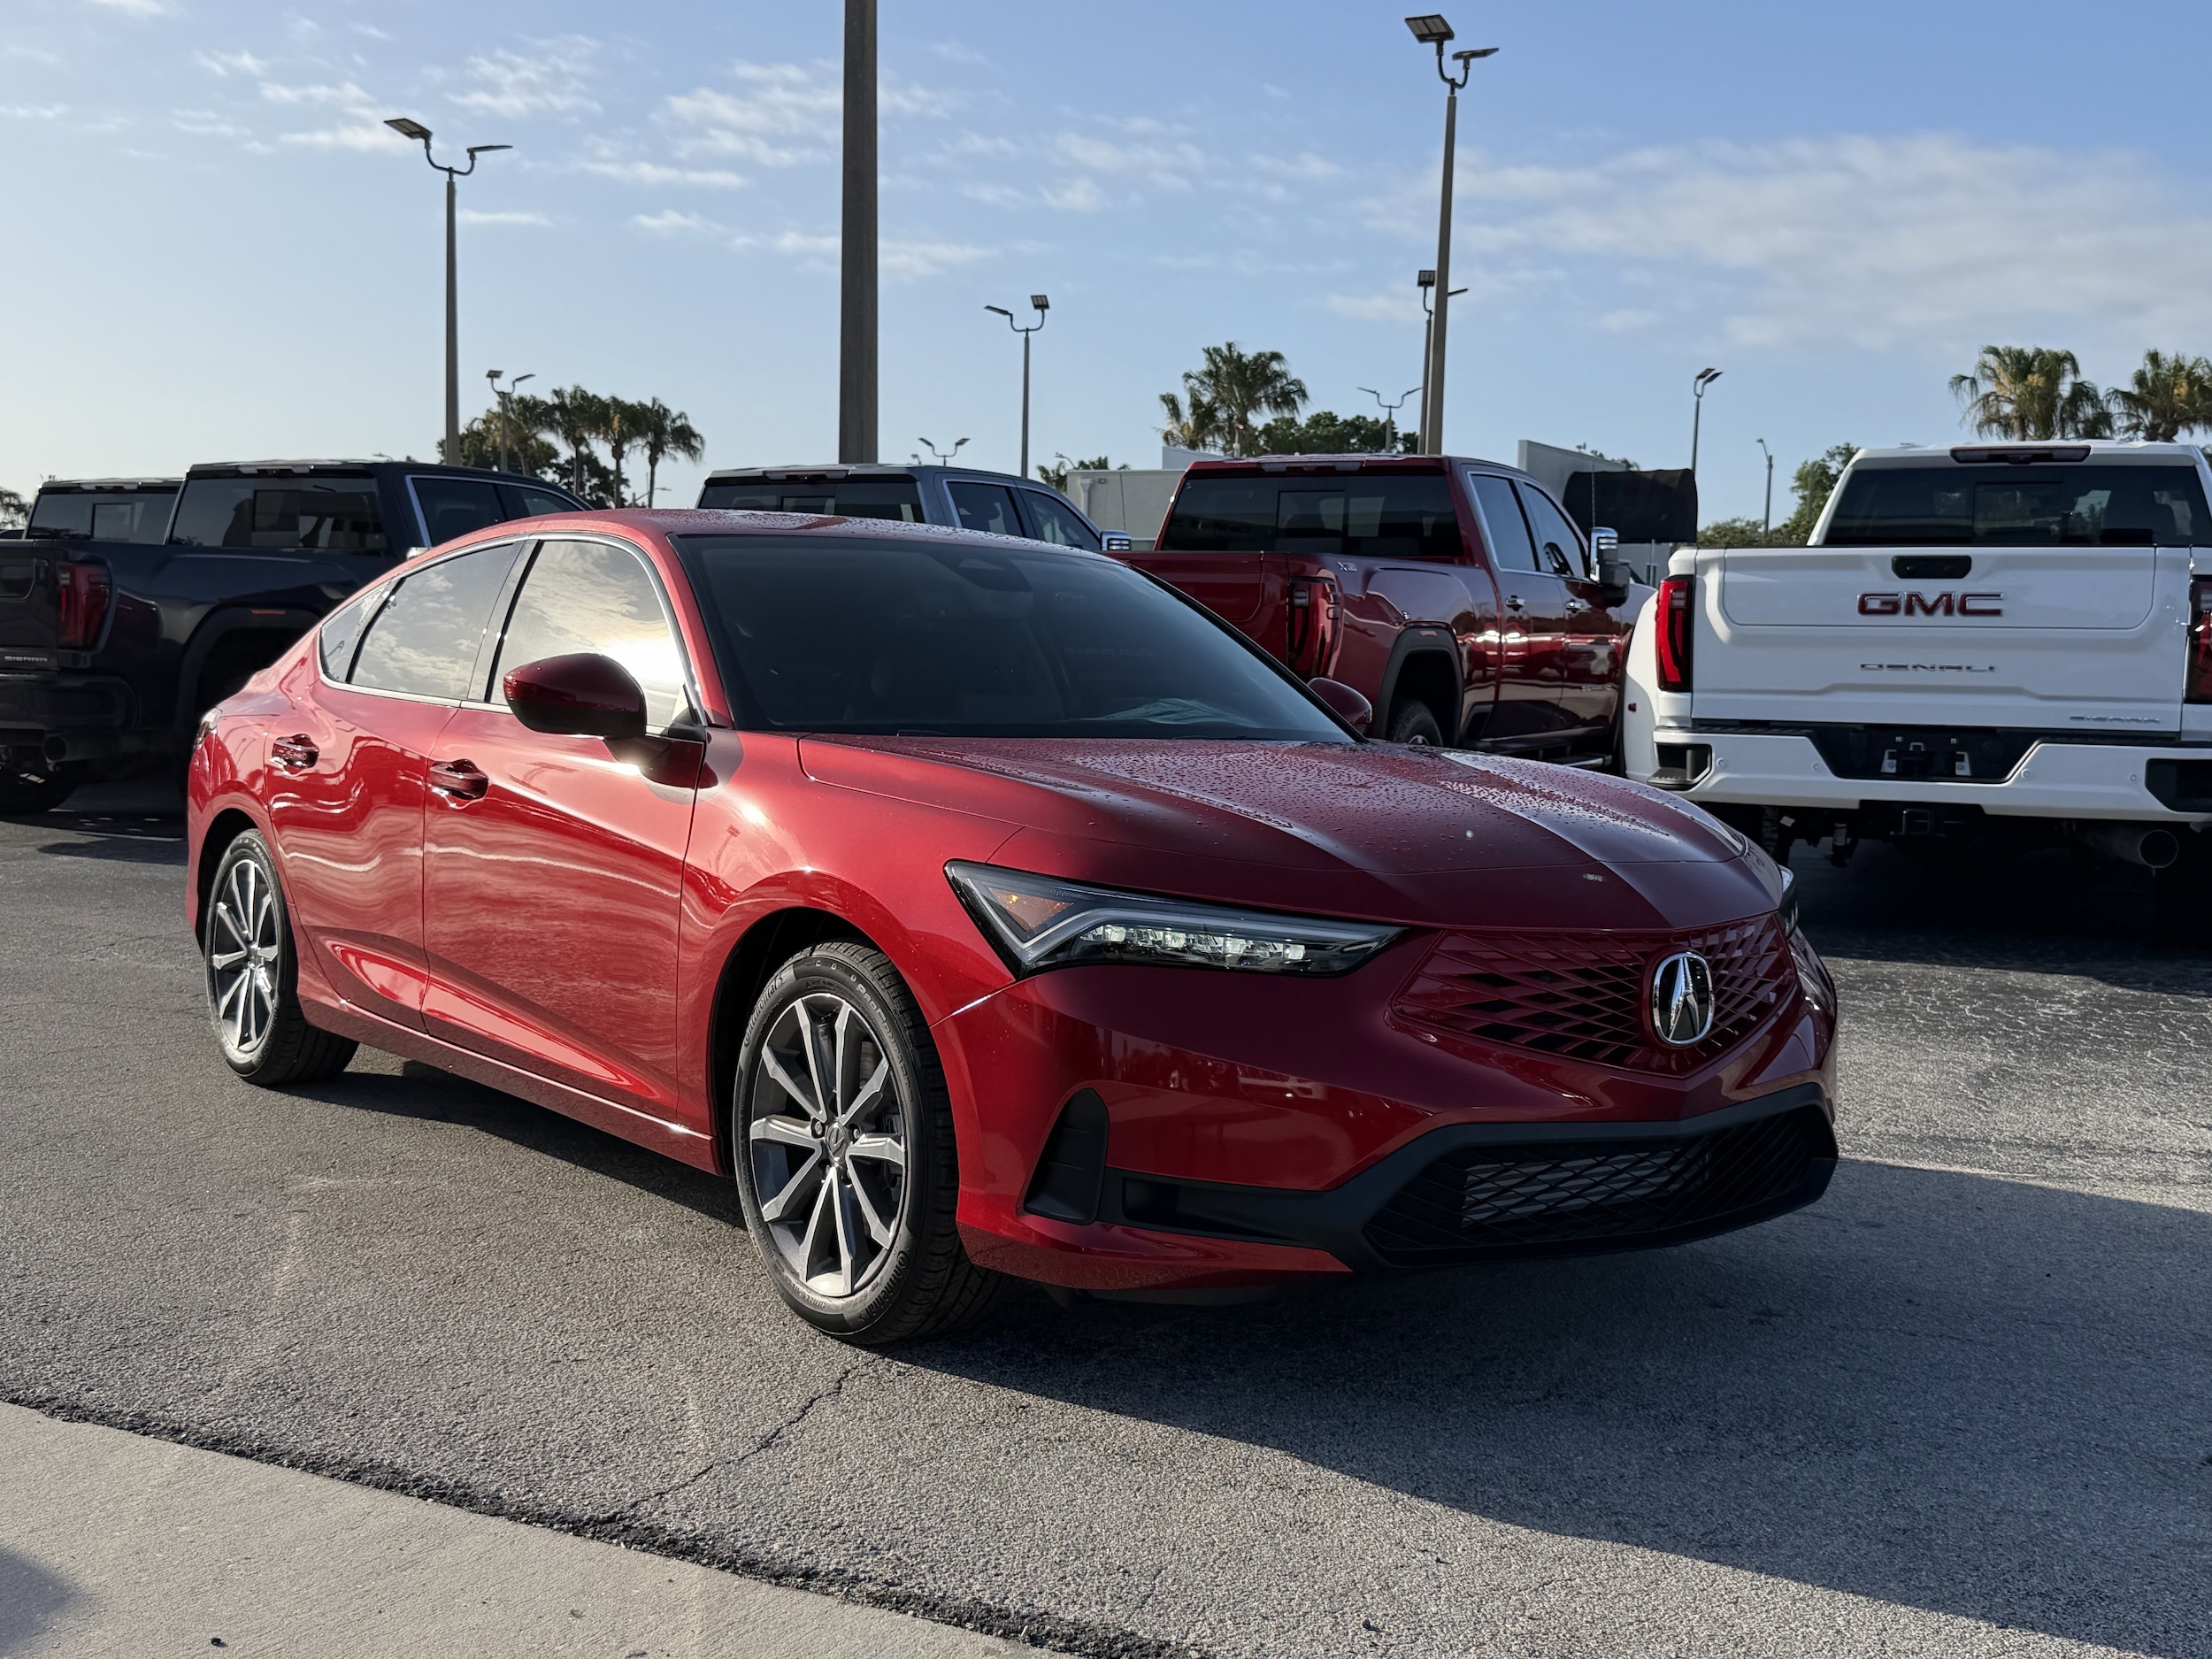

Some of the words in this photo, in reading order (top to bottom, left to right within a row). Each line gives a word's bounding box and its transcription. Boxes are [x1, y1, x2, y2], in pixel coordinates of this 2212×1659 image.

[1857, 591, 2004, 617] GMC
[1860, 664, 1996, 672] DENALI
[743, 978, 779, 1048] Continental
[864, 1249, 910, 1318] Continental
